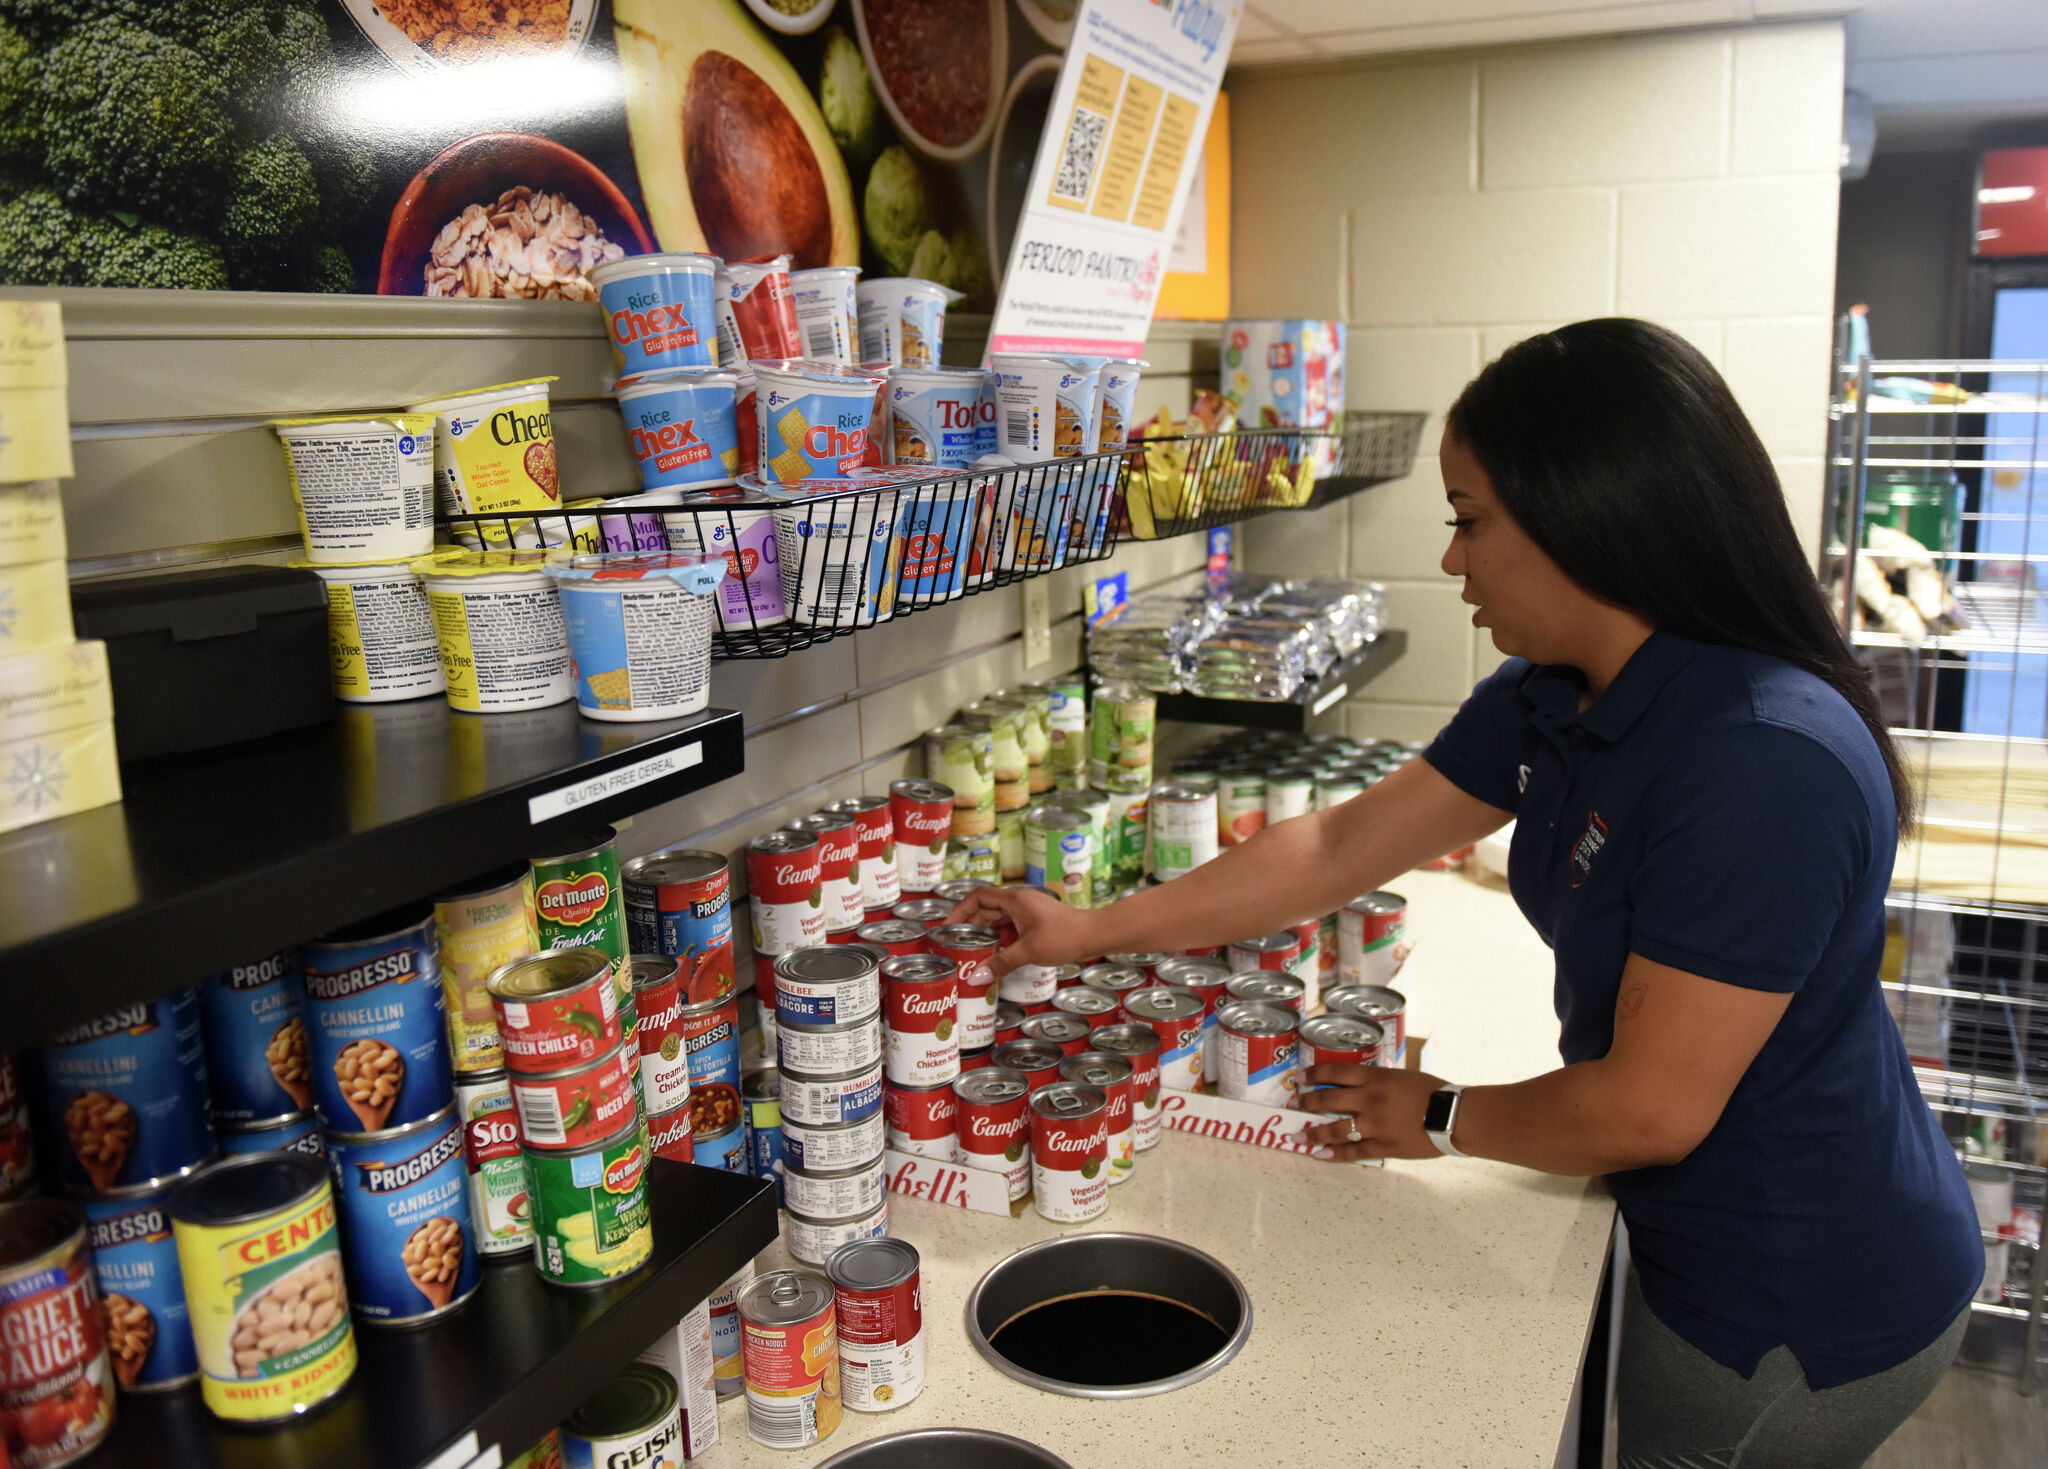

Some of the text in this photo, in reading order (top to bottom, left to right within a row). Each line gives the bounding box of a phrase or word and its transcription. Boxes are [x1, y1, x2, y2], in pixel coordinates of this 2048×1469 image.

[1019, 240, 1084, 277] PERIOD
[628, 290, 661, 310] Rice
[612, 302, 691, 346] Chex
[645, 331, 697, 353] Gluten Free
[640, 409, 670, 429] Rice
[837, 413, 863, 428] Rice
[402, 440, 412, 452] 32
[629, 418, 701, 463] Chex
[475, 461, 502, 471] Toasted
[656, 446, 709, 471] Gluten Free
[471, 468, 511, 481] Whole Grain
[476, 477, 509, 489] Oat Cereal
[902, 519, 928, 532] ice
[903, 560, 954, 577] Gluen ree
[697, 578, 715, 586] PULL
[340, 643, 360, 656] Free
[453, 653, 472, 667] Free
[564, 757, 676, 805] GLUTEN FREE CEREAL
[969, 857, 995, 874] PEAS
[541, 884, 606, 910] Del Monte
[562, 906, 591, 920] Quality
[596, 910, 619, 927] WITH
[461, 937, 495, 953] SWEET
[551, 934, 582, 950] Fresh
[306, 951, 412, 1000] PROGRESSO
[796, 985, 815, 995] BEE
[320, 1002, 405, 1028] CANNELLINI
[327, 1021, 402, 1039] WHITE KIDNEY BEANS
[684, 1015, 721, 1033] pice IT UP
[507, 1033, 579, 1055] GREEN CHILES
[703, 1055, 732, 1072] TORTILLA
[916, 1055, 948, 1069] Chicken
[655, 1065, 681, 1083] Cream
[659, 1075, 687, 1094] Chicken
[843, 1076, 873, 1093] BUMBLE
[665, 1092, 685, 1107] SOUP
[596, 1096, 623, 1122] DICED
[473, 1120, 517, 1148] Sto
[484, 1163, 503, 1176] No
[607, 1173, 624, 1186] Del
[388, 1177, 460, 1218] CANNELLINI
[604, 1218, 641, 1244] KERNEL
[765, 1340, 788, 1348] NOODLE
[224, 1348, 346, 1400] WHITE KIDNEY
